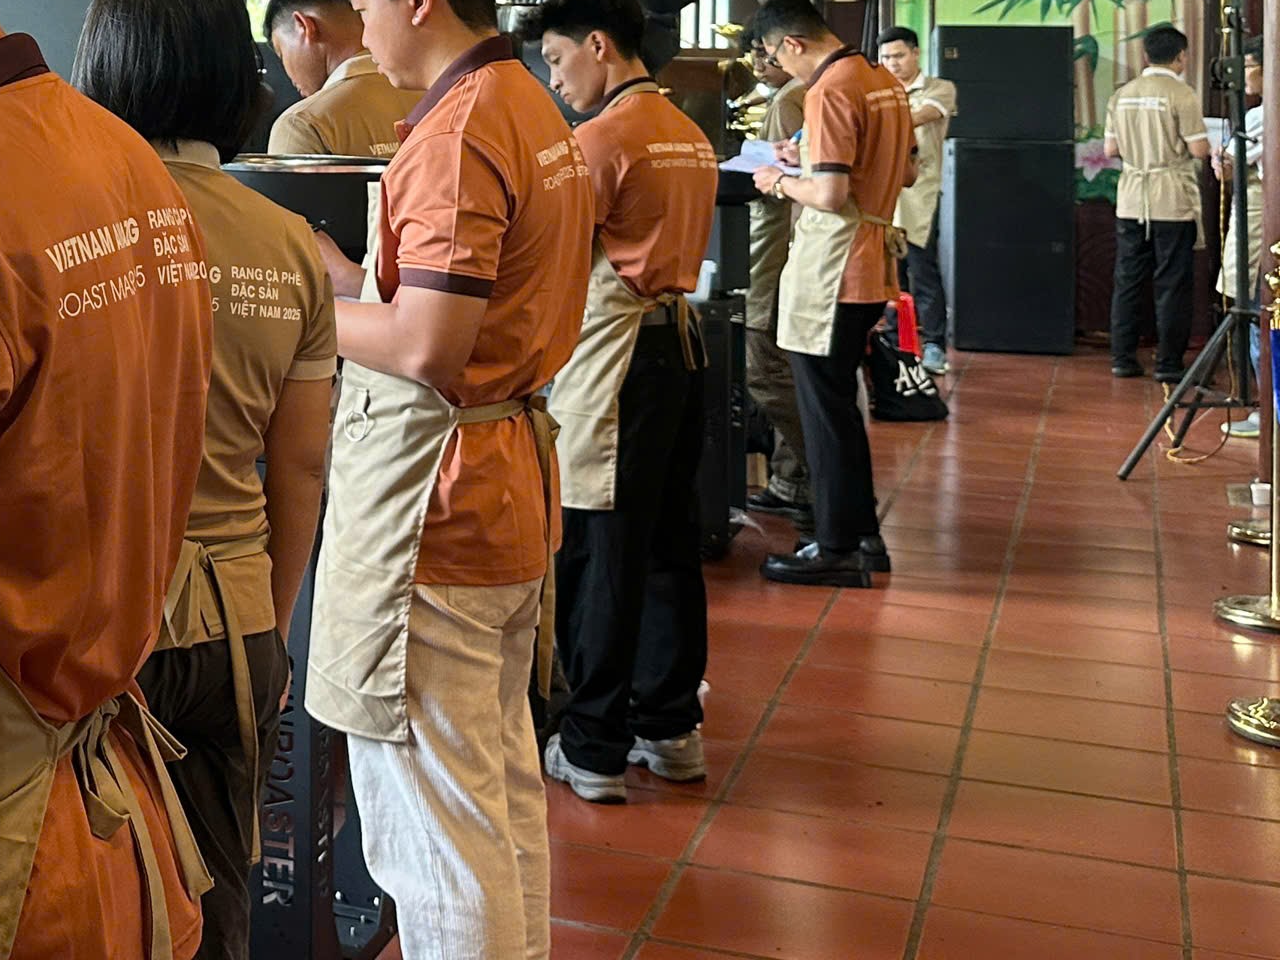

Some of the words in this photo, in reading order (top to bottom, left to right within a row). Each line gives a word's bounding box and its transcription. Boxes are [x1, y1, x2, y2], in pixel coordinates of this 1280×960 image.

[45, 226, 115, 273] VIETNAM
[153, 231, 177, 259] ĐẶC
[157, 258, 183, 287] VIỆT
[231, 265, 263, 281] RANG
[265, 267, 279, 283] CÀ
[231, 281, 256, 300] ĐẶC
[258, 282, 279, 300] SẢN
[229, 300, 257, 318] VIỆT
[259, 304, 281, 319] NAM
[282, 307, 302, 321] 2025
